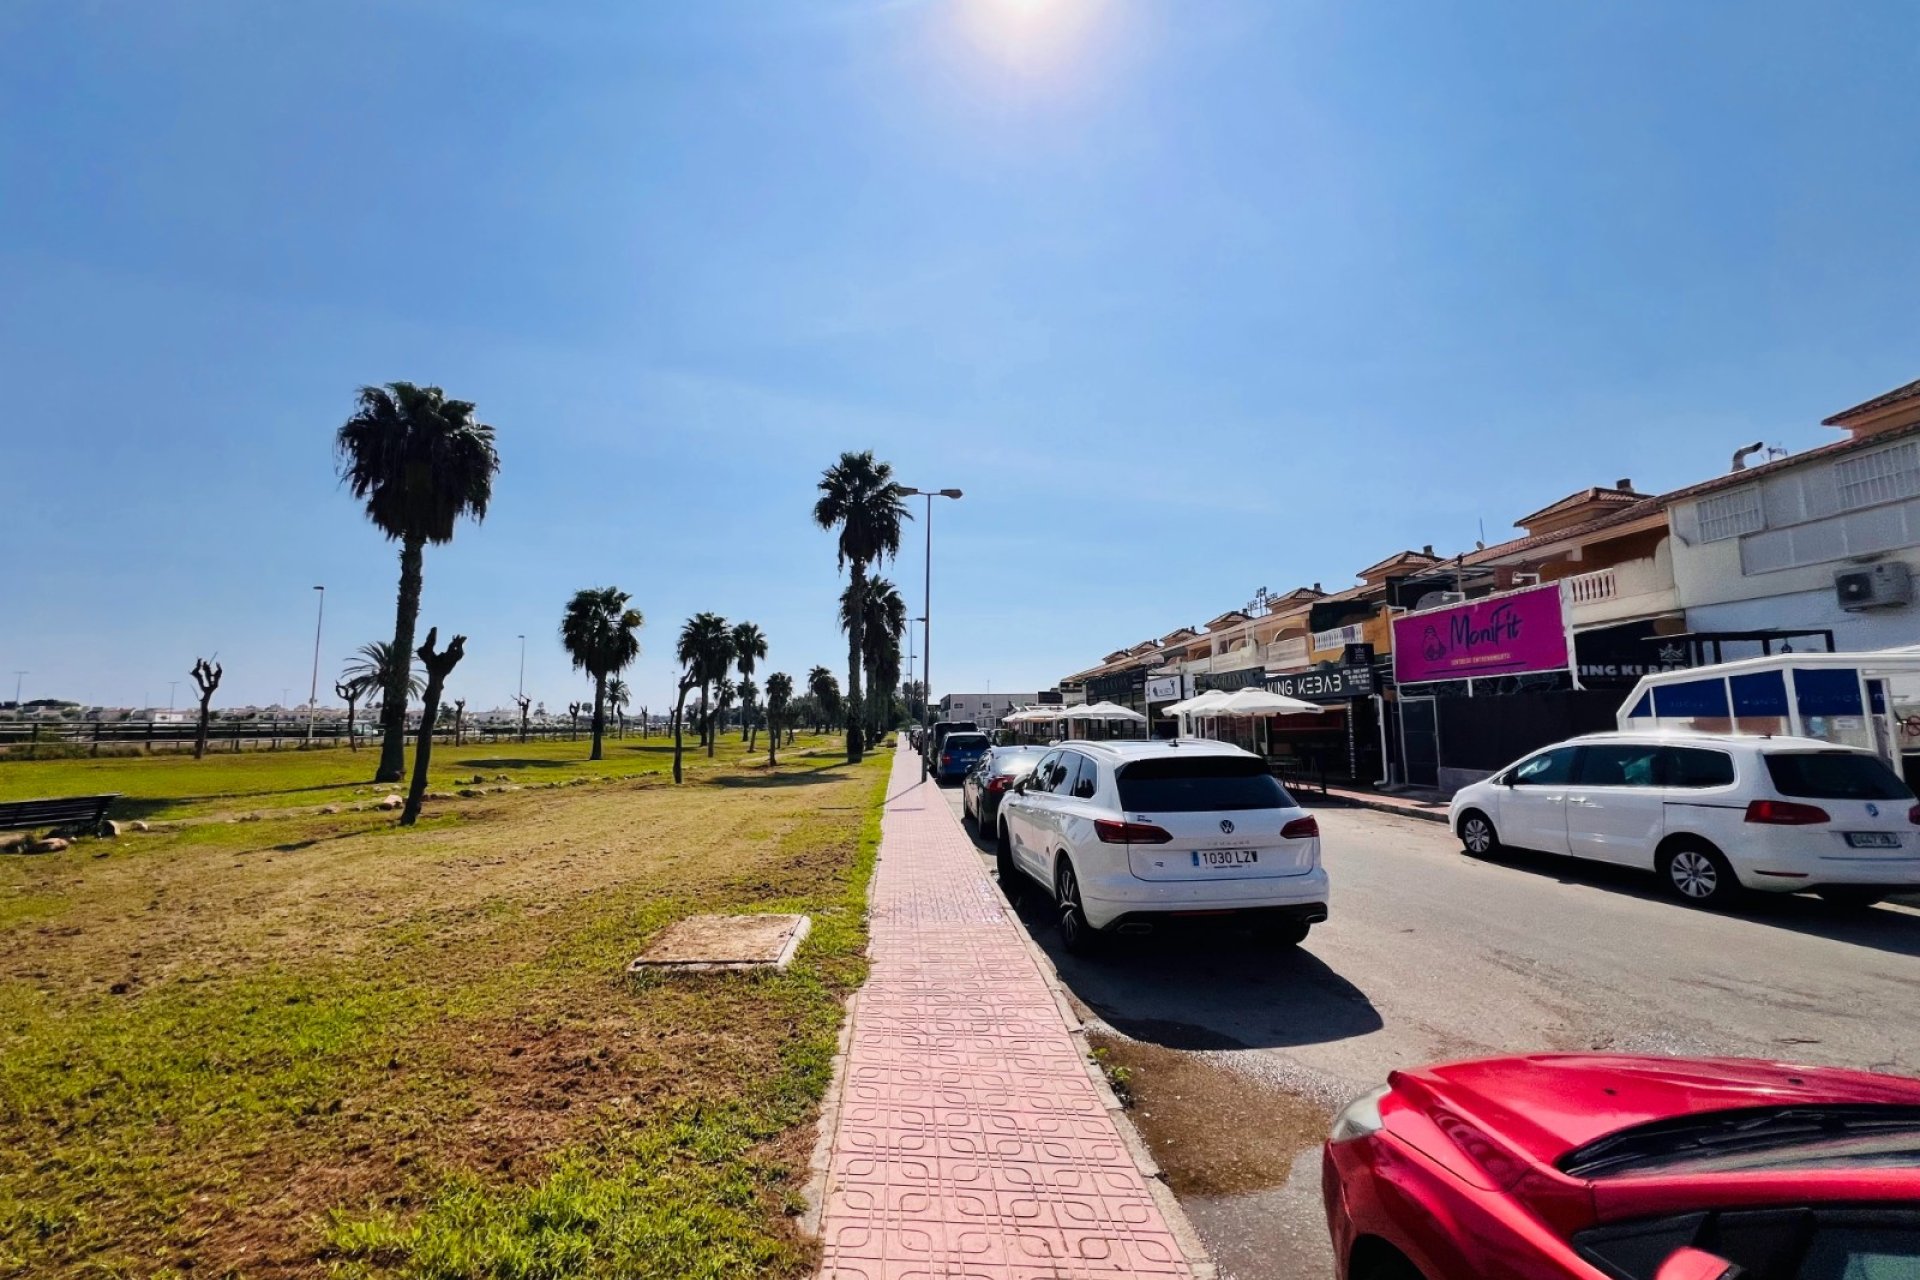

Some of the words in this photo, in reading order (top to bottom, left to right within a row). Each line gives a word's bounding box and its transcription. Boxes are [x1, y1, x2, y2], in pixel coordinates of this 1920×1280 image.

[1451, 603, 1522, 651] MoniFit
[1266, 680, 1293, 696] KING
[1297, 674, 1342, 694] KEBAB
[1203, 851, 1232, 864] 1030
